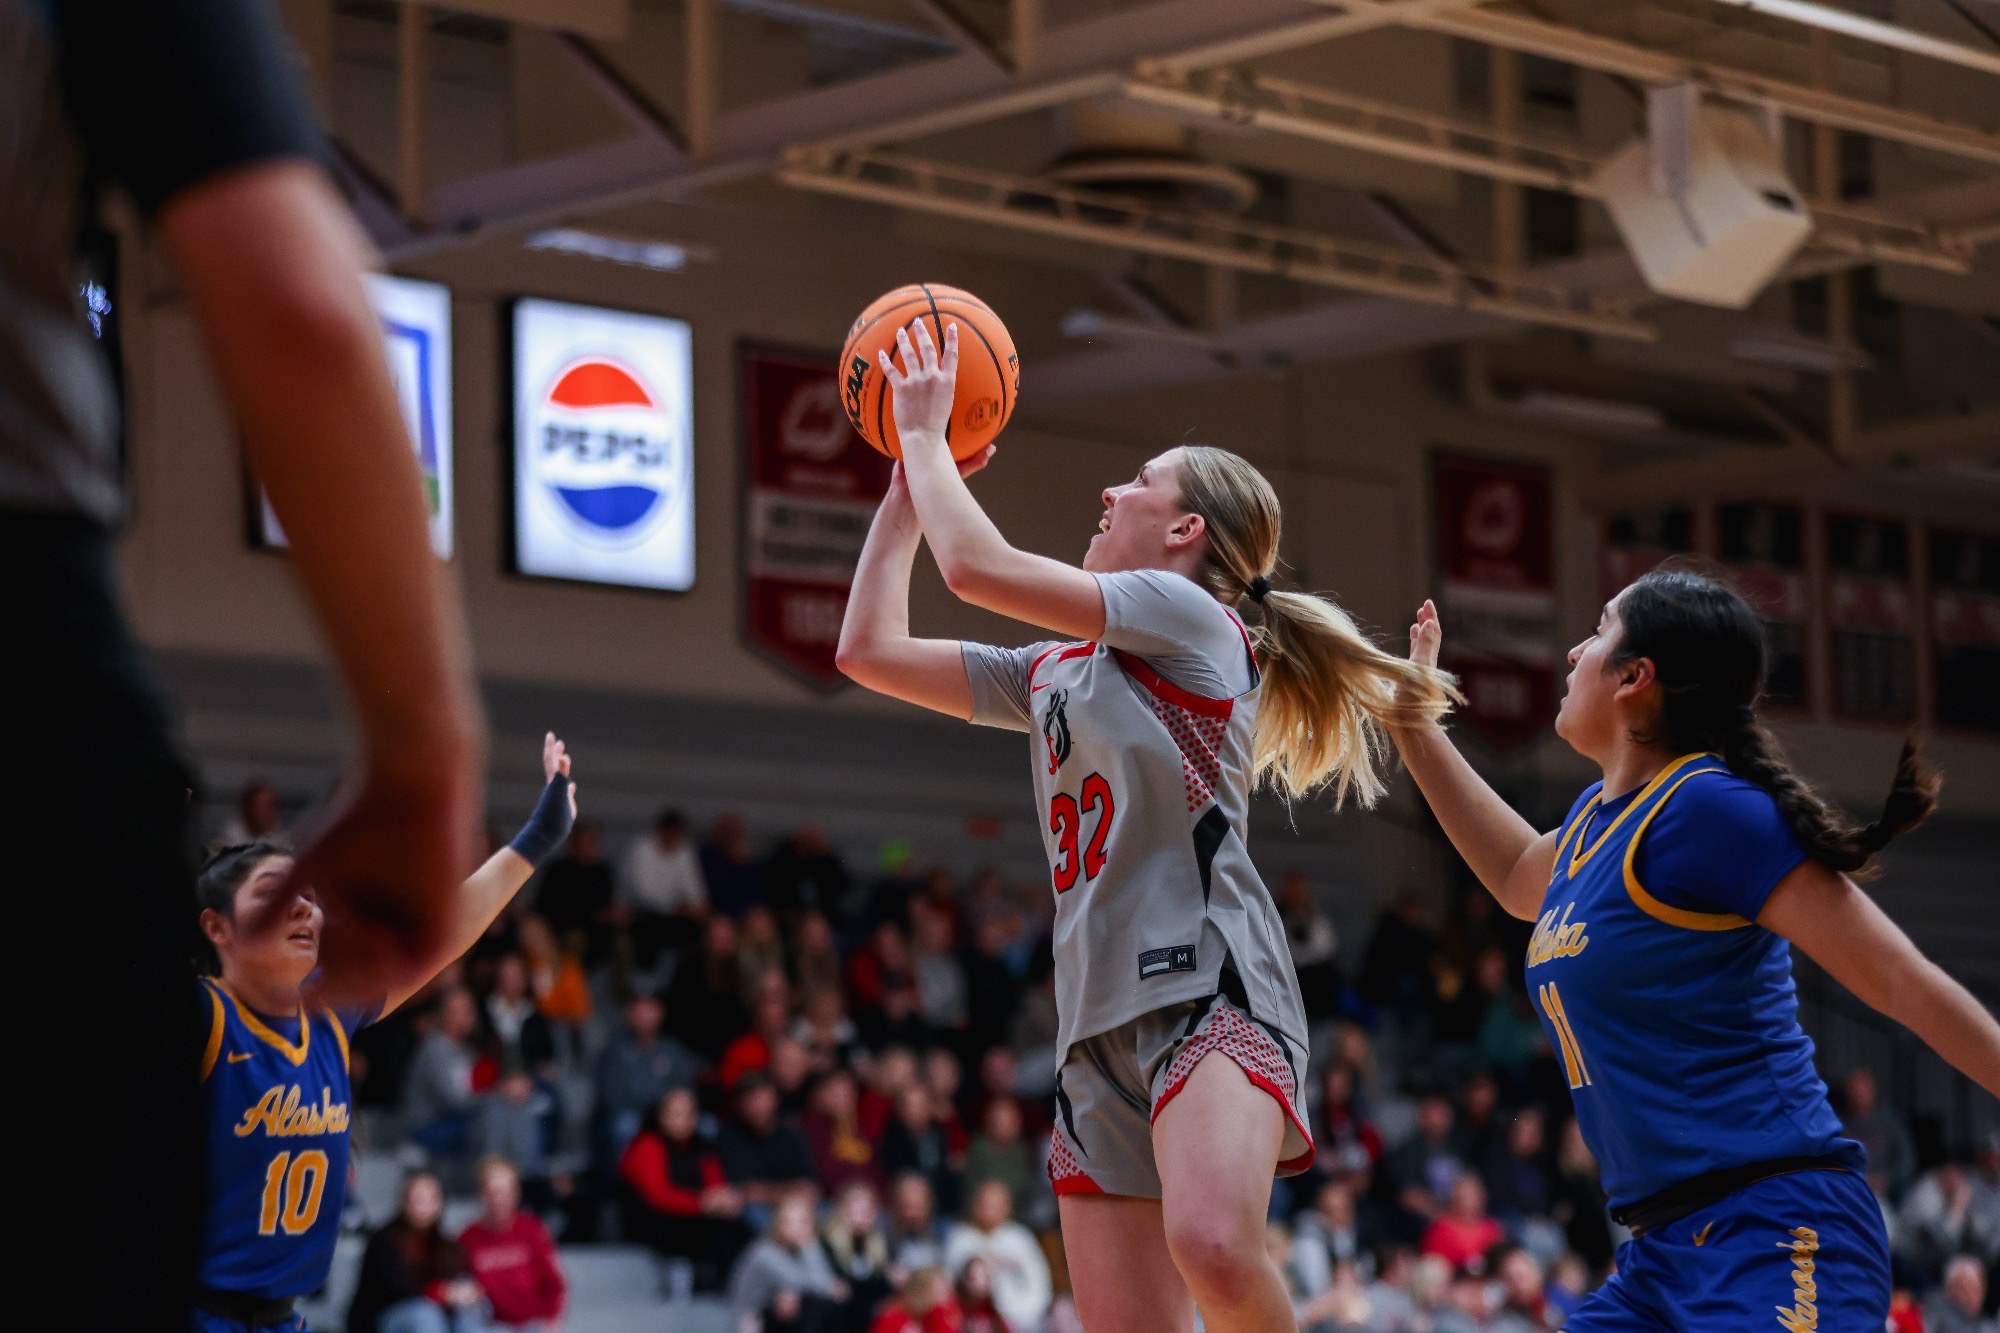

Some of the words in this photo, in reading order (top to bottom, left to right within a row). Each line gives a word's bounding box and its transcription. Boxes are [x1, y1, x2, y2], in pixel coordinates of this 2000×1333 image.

[542, 424, 670, 469] PEPSI
[1050, 771, 1115, 895] 32
[1177, 952, 1188, 964] M
[1539, 981, 1592, 1089] 11
[233, 1084, 350, 1138] Alaska
[258, 1149, 330, 1237] 10
